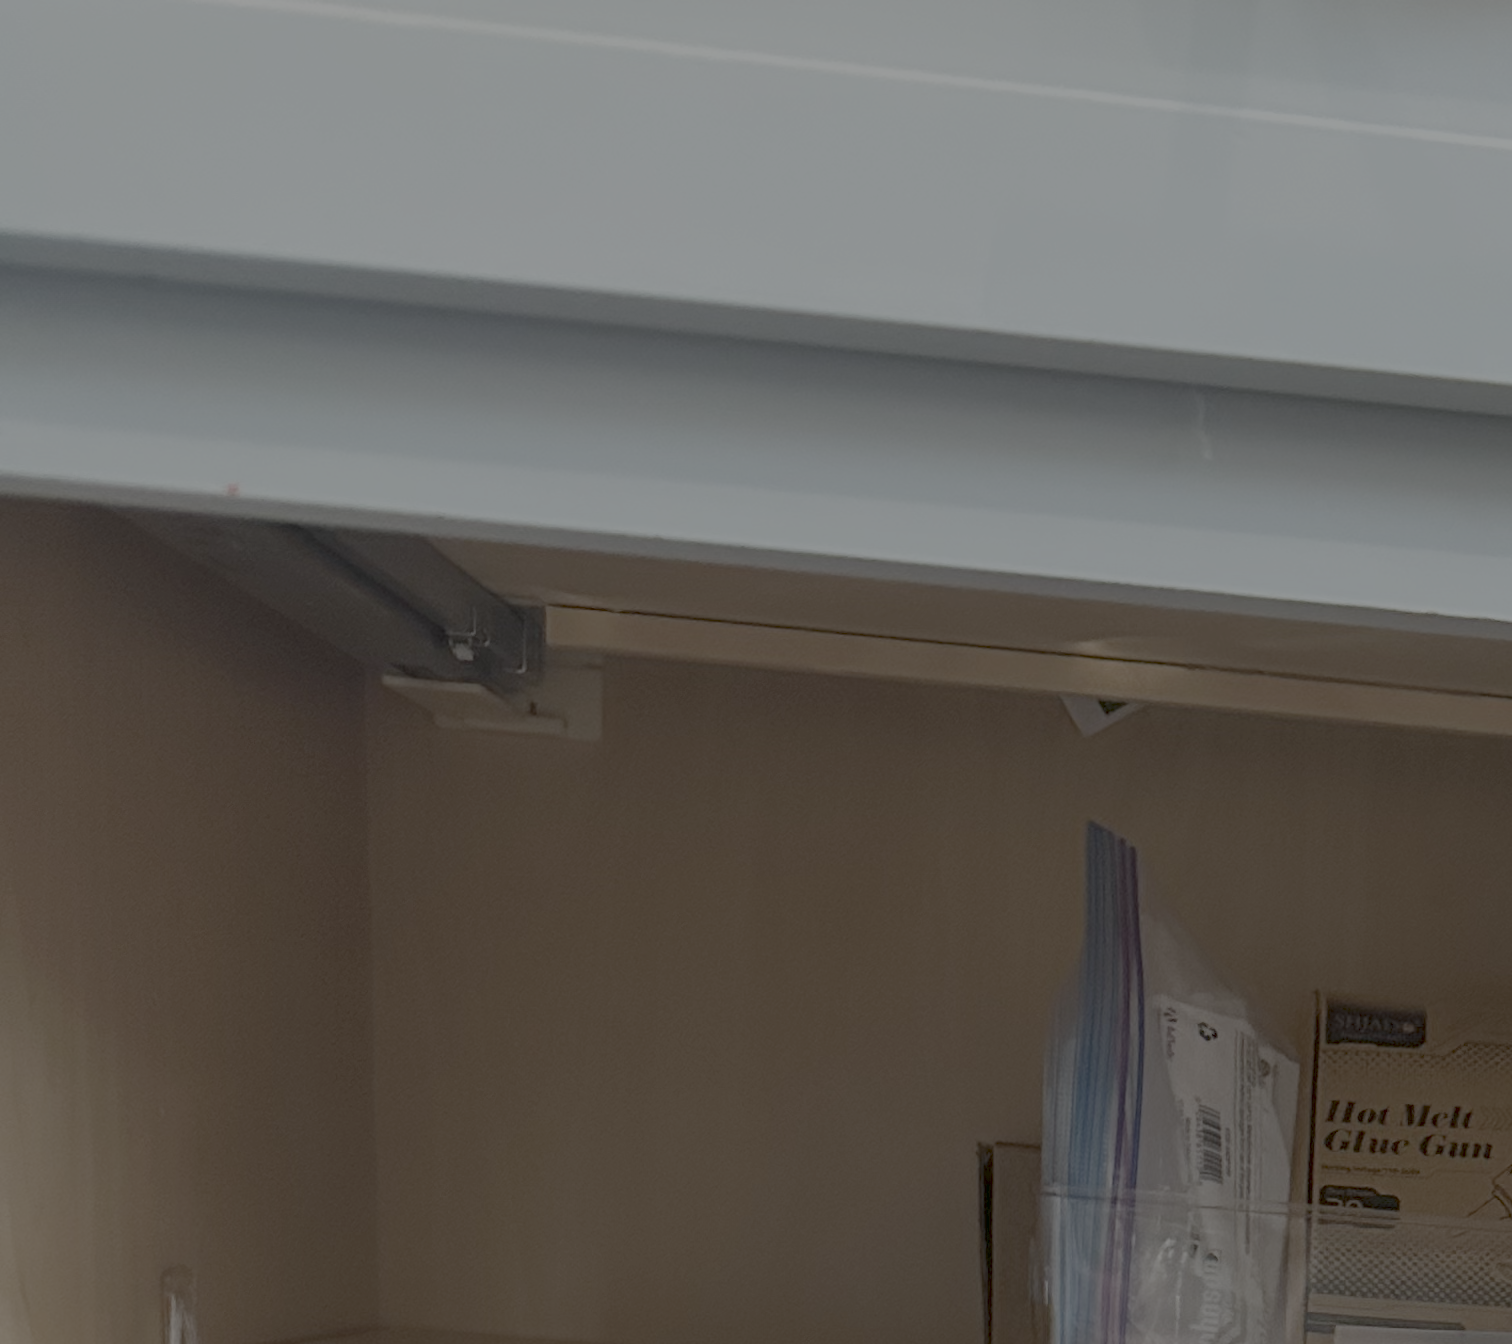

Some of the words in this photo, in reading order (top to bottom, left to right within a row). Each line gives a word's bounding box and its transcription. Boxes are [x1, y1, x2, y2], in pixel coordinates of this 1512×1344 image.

[1325, 1100, 1390, 1126] Hot
[1401, 1103, 1474, 1129] Melt
[1324, 1129, 1410, 1155] Glue
[1419, 1134, 1494, 1160] Gun
